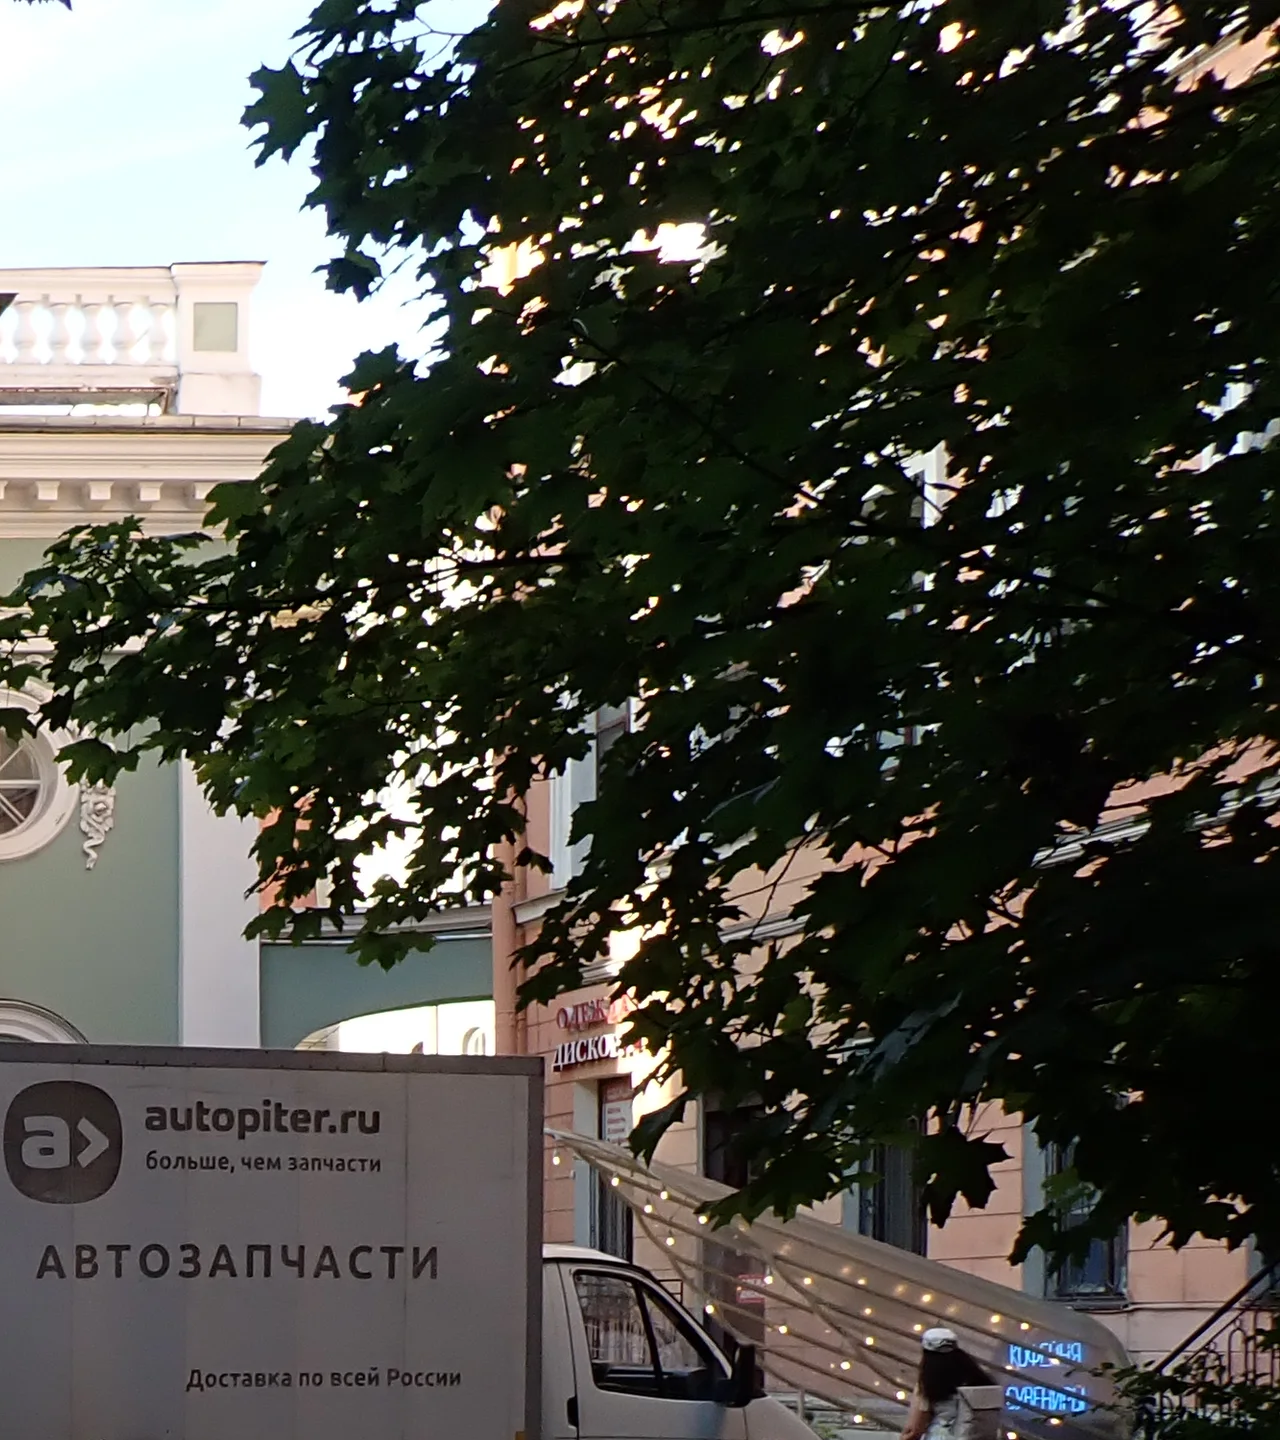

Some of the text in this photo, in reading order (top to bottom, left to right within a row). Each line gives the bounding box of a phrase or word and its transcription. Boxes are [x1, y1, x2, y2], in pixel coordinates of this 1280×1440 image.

[145, 1099, 381, 1140] autopiter.ru
[146, 1150, 382, 1173] больше, чем запчасти
[36, 1243, 439, 1280] АВТОЗАПЧАСТИ
[185, 1366, 462, 1393] Доставка по всей России
